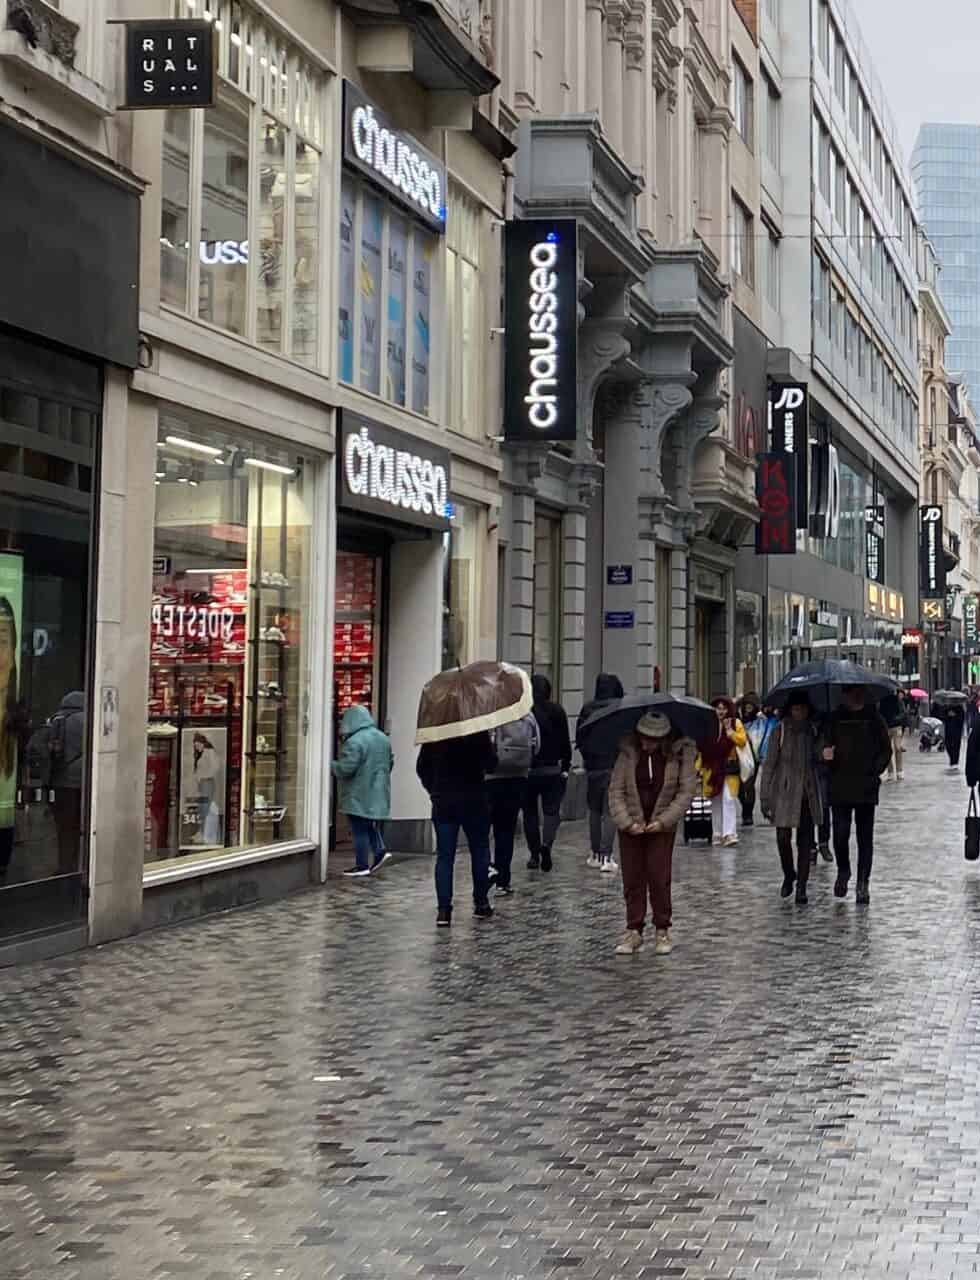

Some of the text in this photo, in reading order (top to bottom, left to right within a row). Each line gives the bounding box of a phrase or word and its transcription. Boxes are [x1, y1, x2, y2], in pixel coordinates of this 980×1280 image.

[142, 37, 198, 52] RIT
[143, 58, 198, 73] UAL
[524, 241, 558, 429] chaussea
[774, 387, 804, 410] JD
[923, 507, 941, 521] JD
[966, 604, 977, 641] JULES
